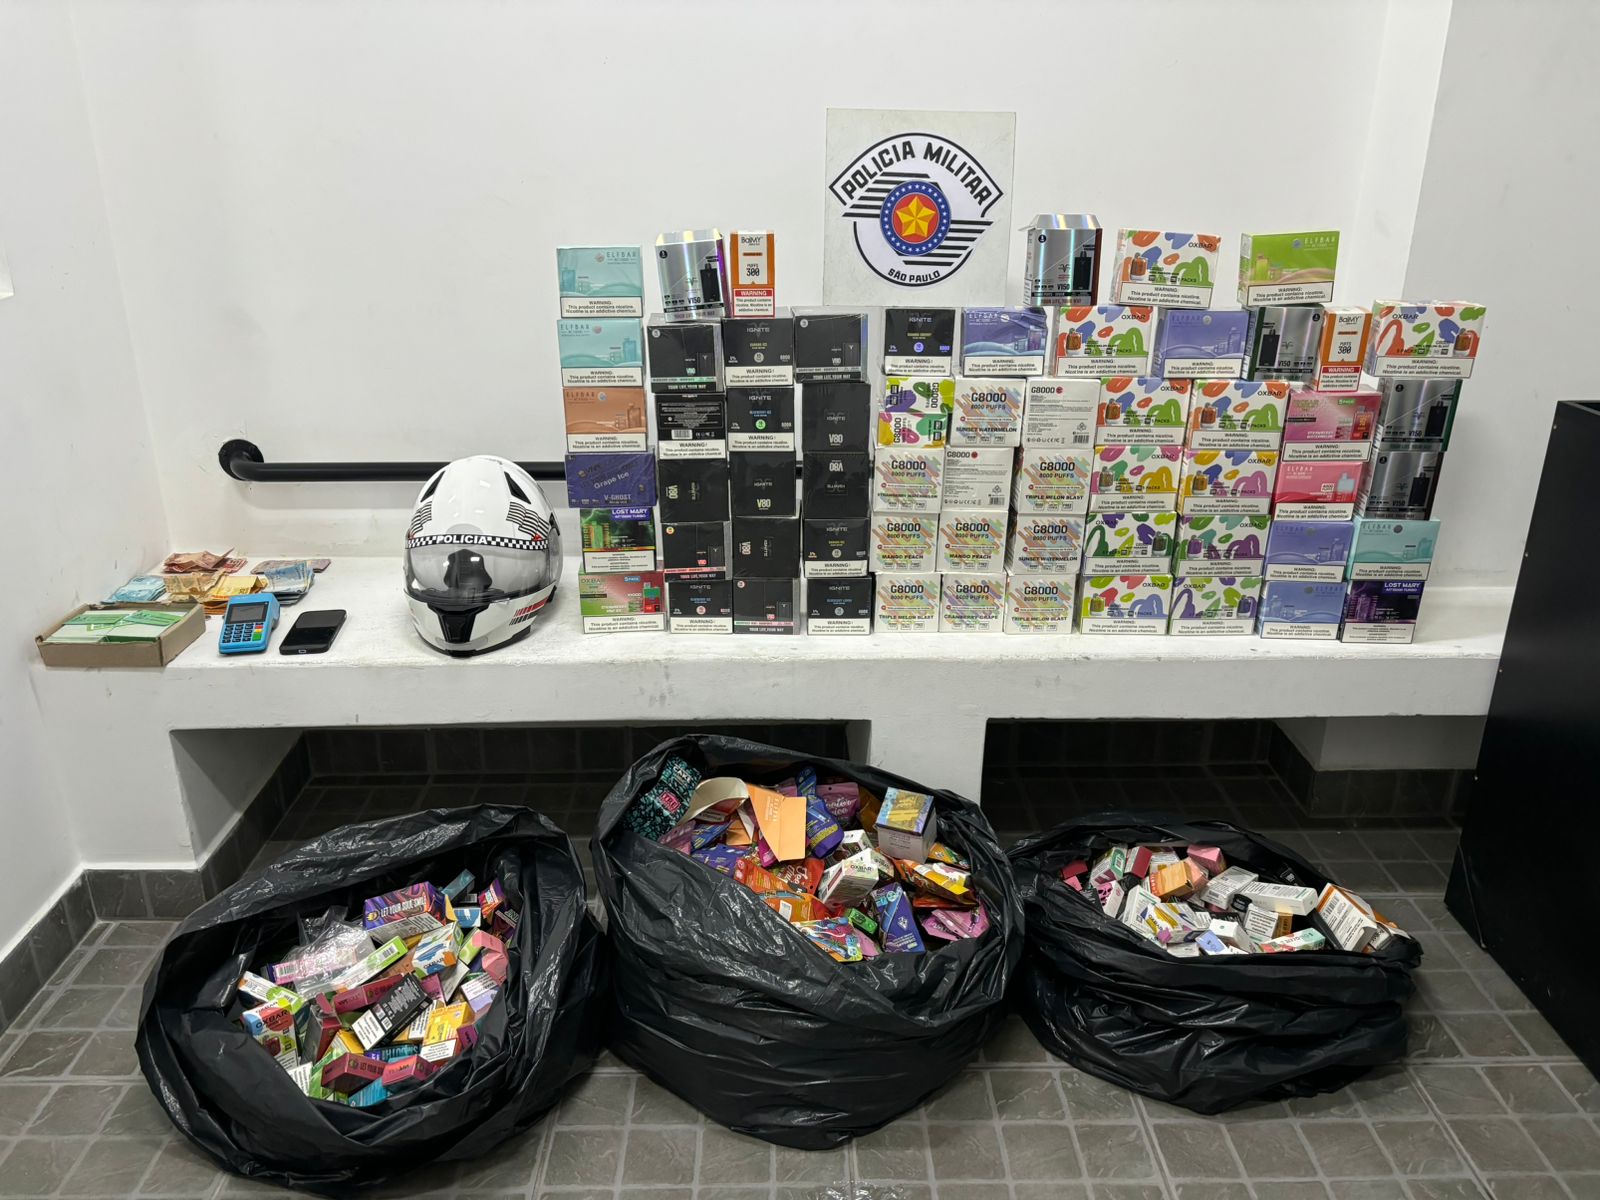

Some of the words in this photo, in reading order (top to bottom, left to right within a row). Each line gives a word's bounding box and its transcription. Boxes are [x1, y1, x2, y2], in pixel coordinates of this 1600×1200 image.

[922, 142, 993, 206] MILITAR
[1304, 236, 1336, 245] ELFBAR
[746, 267, 760, 277] 300
[887, 267, 907, 282] SÃO
[908, 269, 941, 283] PAULO
[1337, 345, 1352, 355] 300
[831, 357, 842, 366] V80
[1031, 386, 1055, 394] G8000
[971, 392, 1007, 403] G8000
[893, 417, 901, 443] G8000
[828, 433, 844, 444] V80
[891, 459, 927, 471] G8000
[1039, 461, 1075, 472] G8000
[593, 477, 617, 490] Grape
[617, 471, 630, 480] Ice
[668, 485, 678, 499] V80
[757, 499, 771, 508] V80
[886, 522, 921, 532] G8000
[955, 522, 990, 532] G8000
[1033, 524, 1068, 534] G8000
[437, 534, 488, 545] POLÍCIA
[741, 541, 751, 555] V80
[890, 584, 924, 594] G8000
[955, 584, 990, 594] G8000
[1024, 586, 1058, 596] G8000
[256, 1009, 288, 1029] OXBAR
